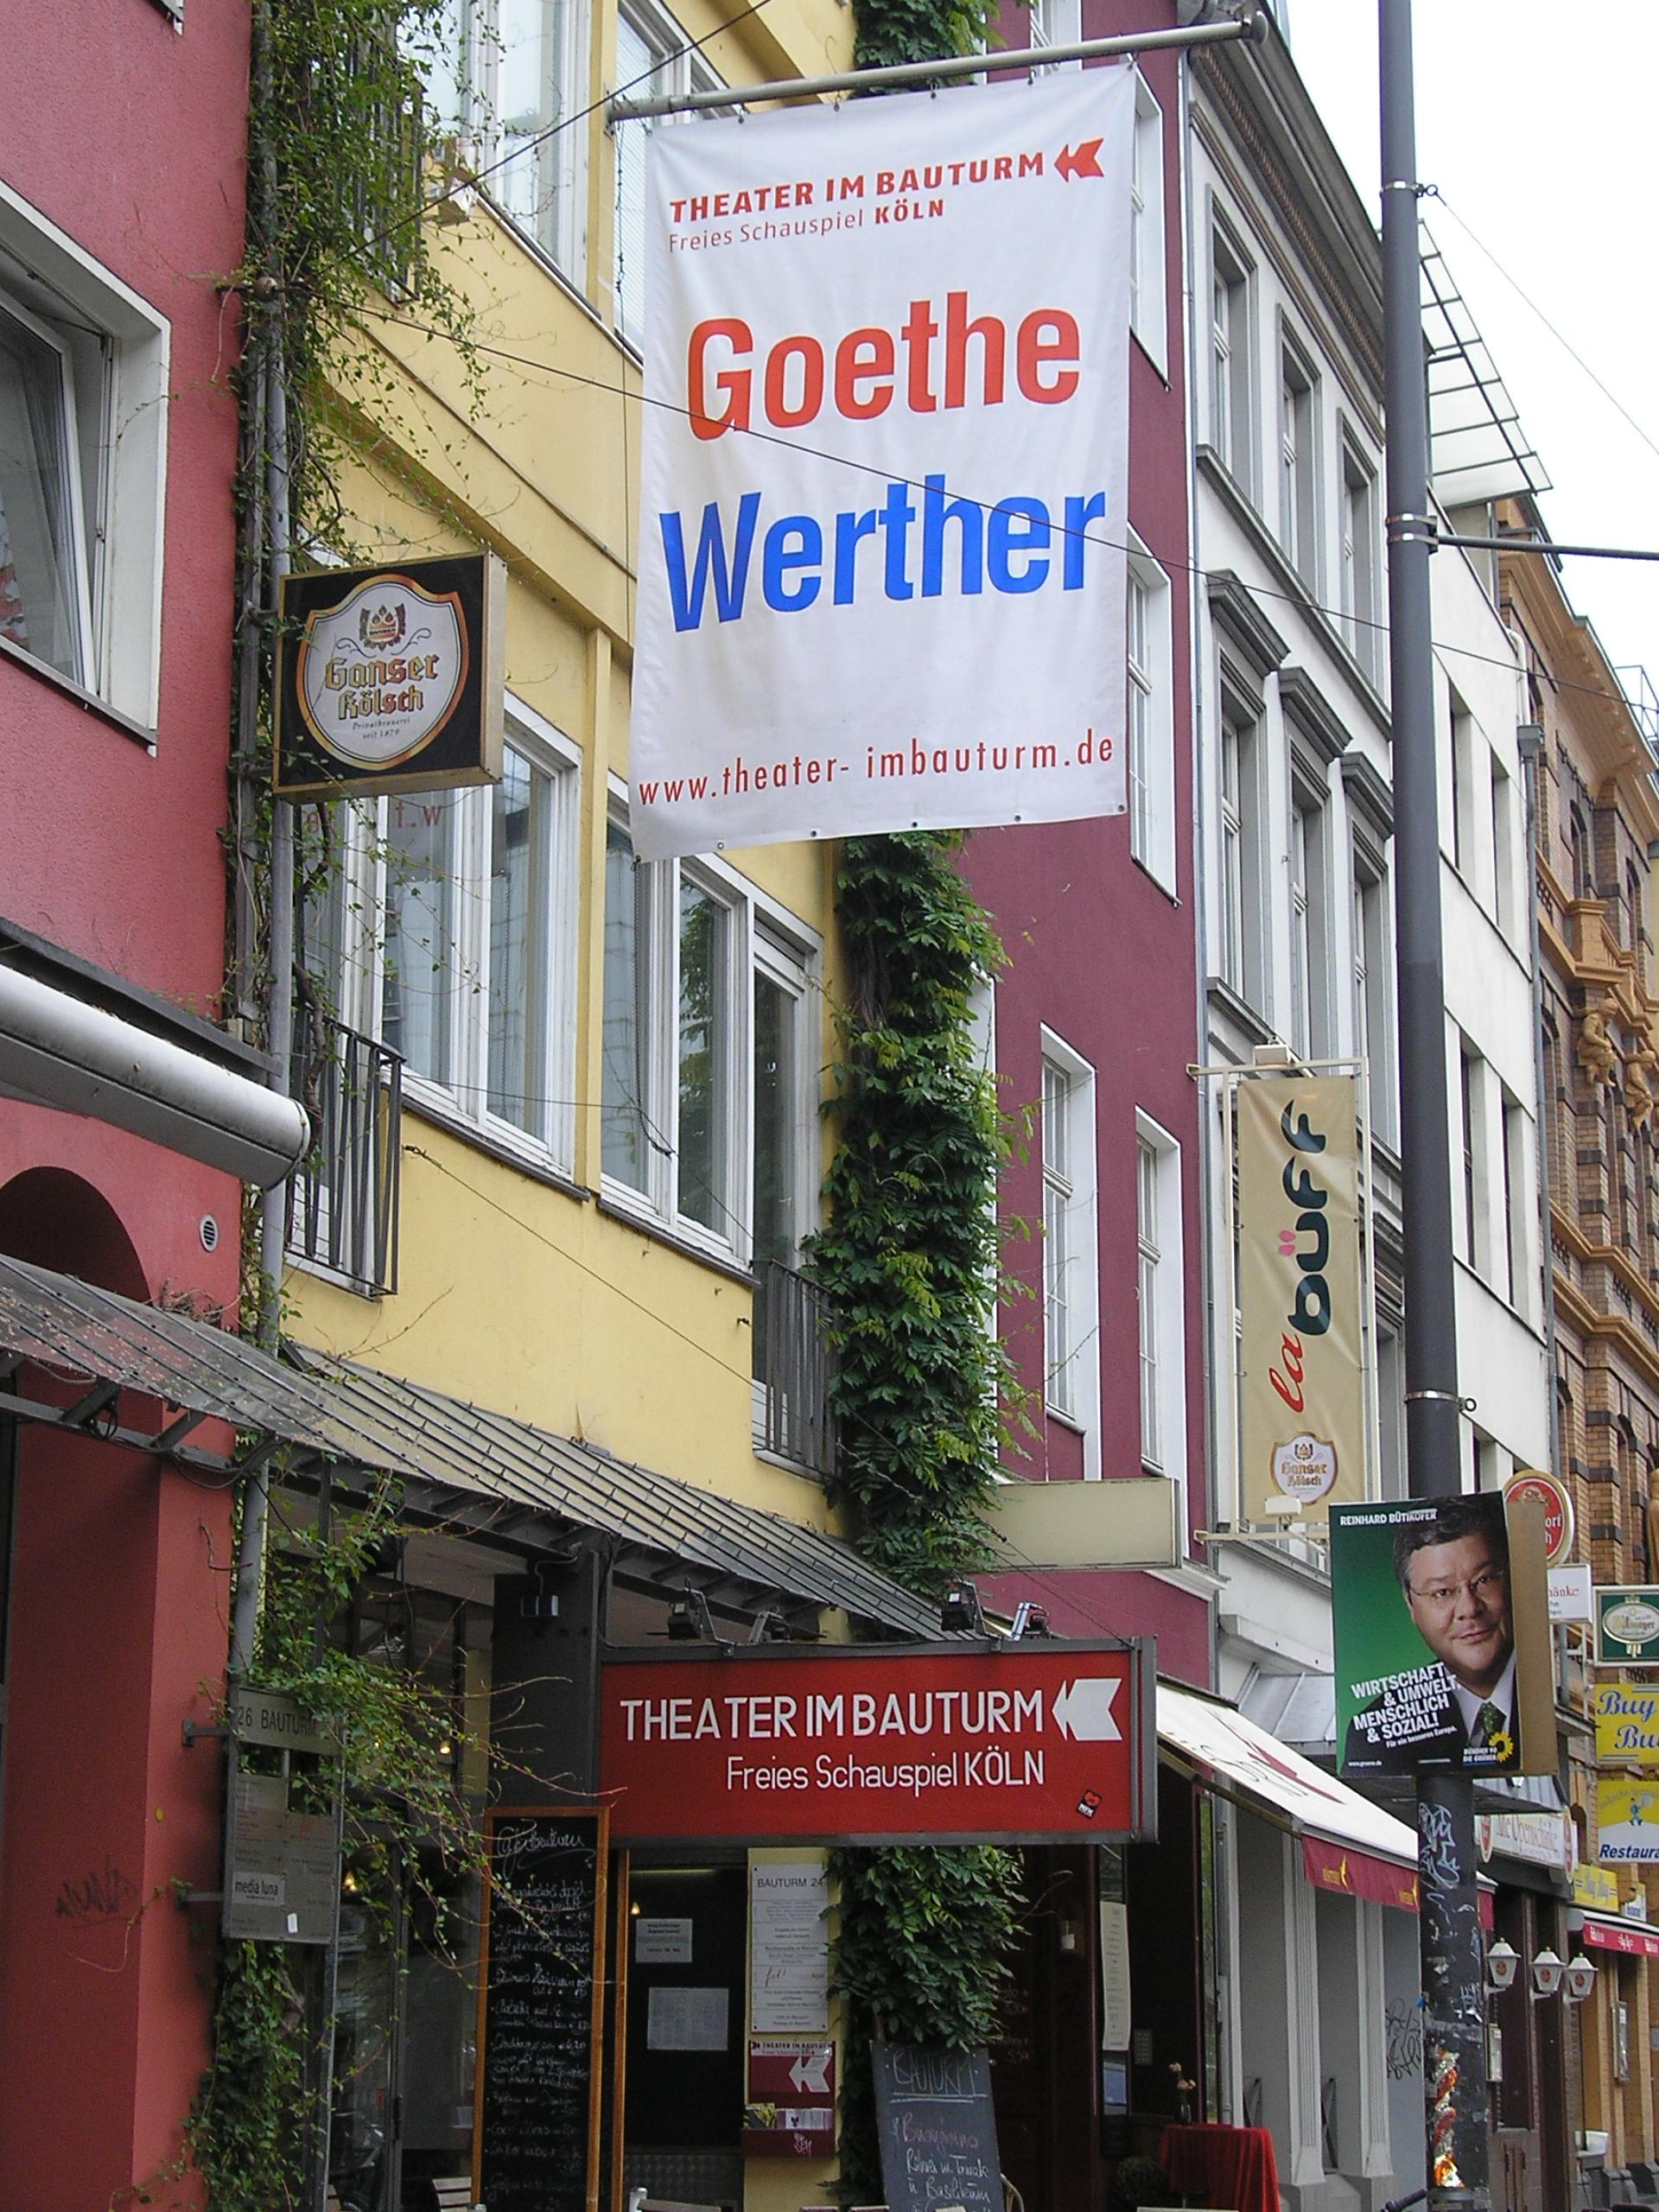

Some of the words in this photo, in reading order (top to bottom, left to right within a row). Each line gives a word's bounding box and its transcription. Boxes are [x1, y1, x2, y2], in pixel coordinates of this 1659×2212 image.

[670, 181, 815, 224] THEATER
[825, 174, 866, 202] IM
[875, 151, 1045, 196] BAUTURM
[668, 229, 734, 253] Freies
[739, 209, 863, 244] Schauspiel
[874, 197, 945, 225] KÖLN
[687, 289, 1081, 442] Goethe
[658, 474, 1106, 633] Werther
[324, 653, 441, 691] Ganser
[338, 684, 424, 721] Kölsch
[866, 728, 1114, 779] imbauturm.de
[1278, 1098, 1331, 1336] büff
[1268, 1328, 1307, 1414] la
[1281, 1460, 1328, 1476] Ganser
[1339, 1513, 1388, 1527] REINHARD
[1350, 1661, 1446, 1700] WIRTSCHAFT
[1383, 1692, 1397, 1707] &
[238, 1706, 253, 1726] 26
[619, 1697, 798, 1741] THEATER
[806, 1694, 843, 1737] IM
[852, 1688, 1043, 1737] BAUTURM
[1353, 1694, 1451, 1732] MENSCHLICH
[1596, 1689, 1656, 1723] Buy
[1366, 1726, 1381, 1745] &
[1382, 1711, 1440, 1740] SOZIAL!
[1385, 1738, 1397, 1750] Für
[1613, 1724, 1659, 1750] Bu
[727, 1755, 809, 1790] Freies
[815, 1751, 957, 1797] Schauspiel
[963, 1745, 1045, 1786] KÖLN
[235, 1878, 259, 1894] media
[260, 1880, 279, 1896] luna
[757, 1878, 807, 1888] BAUTURM
[810, 1878, 823, 1887] 24
